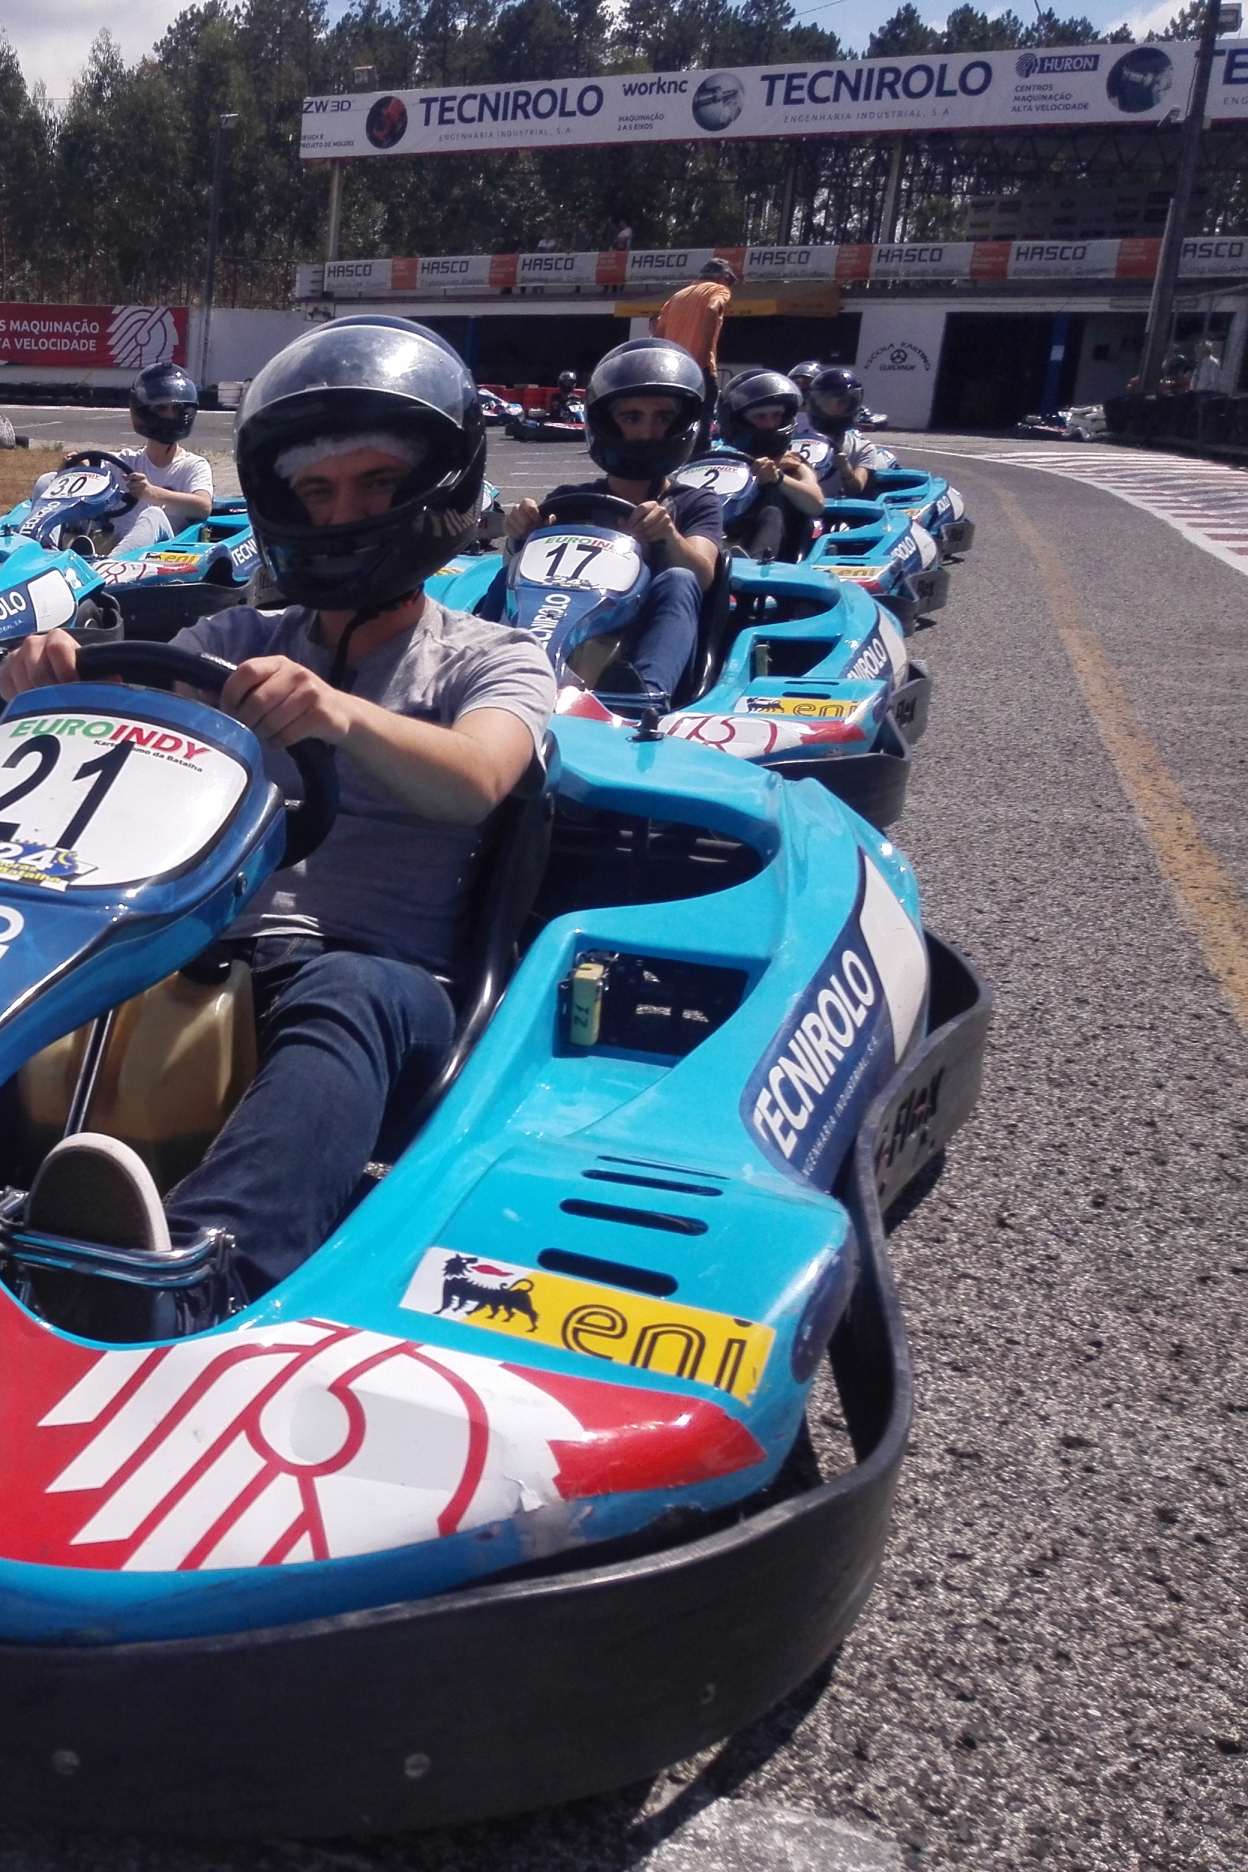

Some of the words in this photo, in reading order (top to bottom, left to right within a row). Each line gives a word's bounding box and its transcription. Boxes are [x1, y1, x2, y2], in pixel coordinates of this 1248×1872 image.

[1044, 57, 1094, 71] HURON
[622, 76, 688, 96] worknc
[760, 61, 992, 106] TECNIROLO
[420, 85, 603, 126] TECNIROLO
[877, 248, 945, 263] HASCO
[1015, 246, 1087, 261] HASCO
[1182, 242, 1243, 258] ASCO
[521, 257, 575, 271] HASCO
[631, 254, 688, 268] HASCO
[749, 251, 810, 266] HASCO
[327, 263, 373, 277] HASCO
[421, 260, 470, 274] HASCO
[9, 319, 100, 336] MAQUINAÇÃO
[15, 338, 97, 351] VELOCIDADE
[50, 476, 88, 496] 30
[698, 468, 720, 489] 2
[546, 542, 603, 579] 17
[9, 718, 213, 761] EUROINDY
[167, 755, 203, 773] Batalha
[561, 1304, 753, 1394] eni
